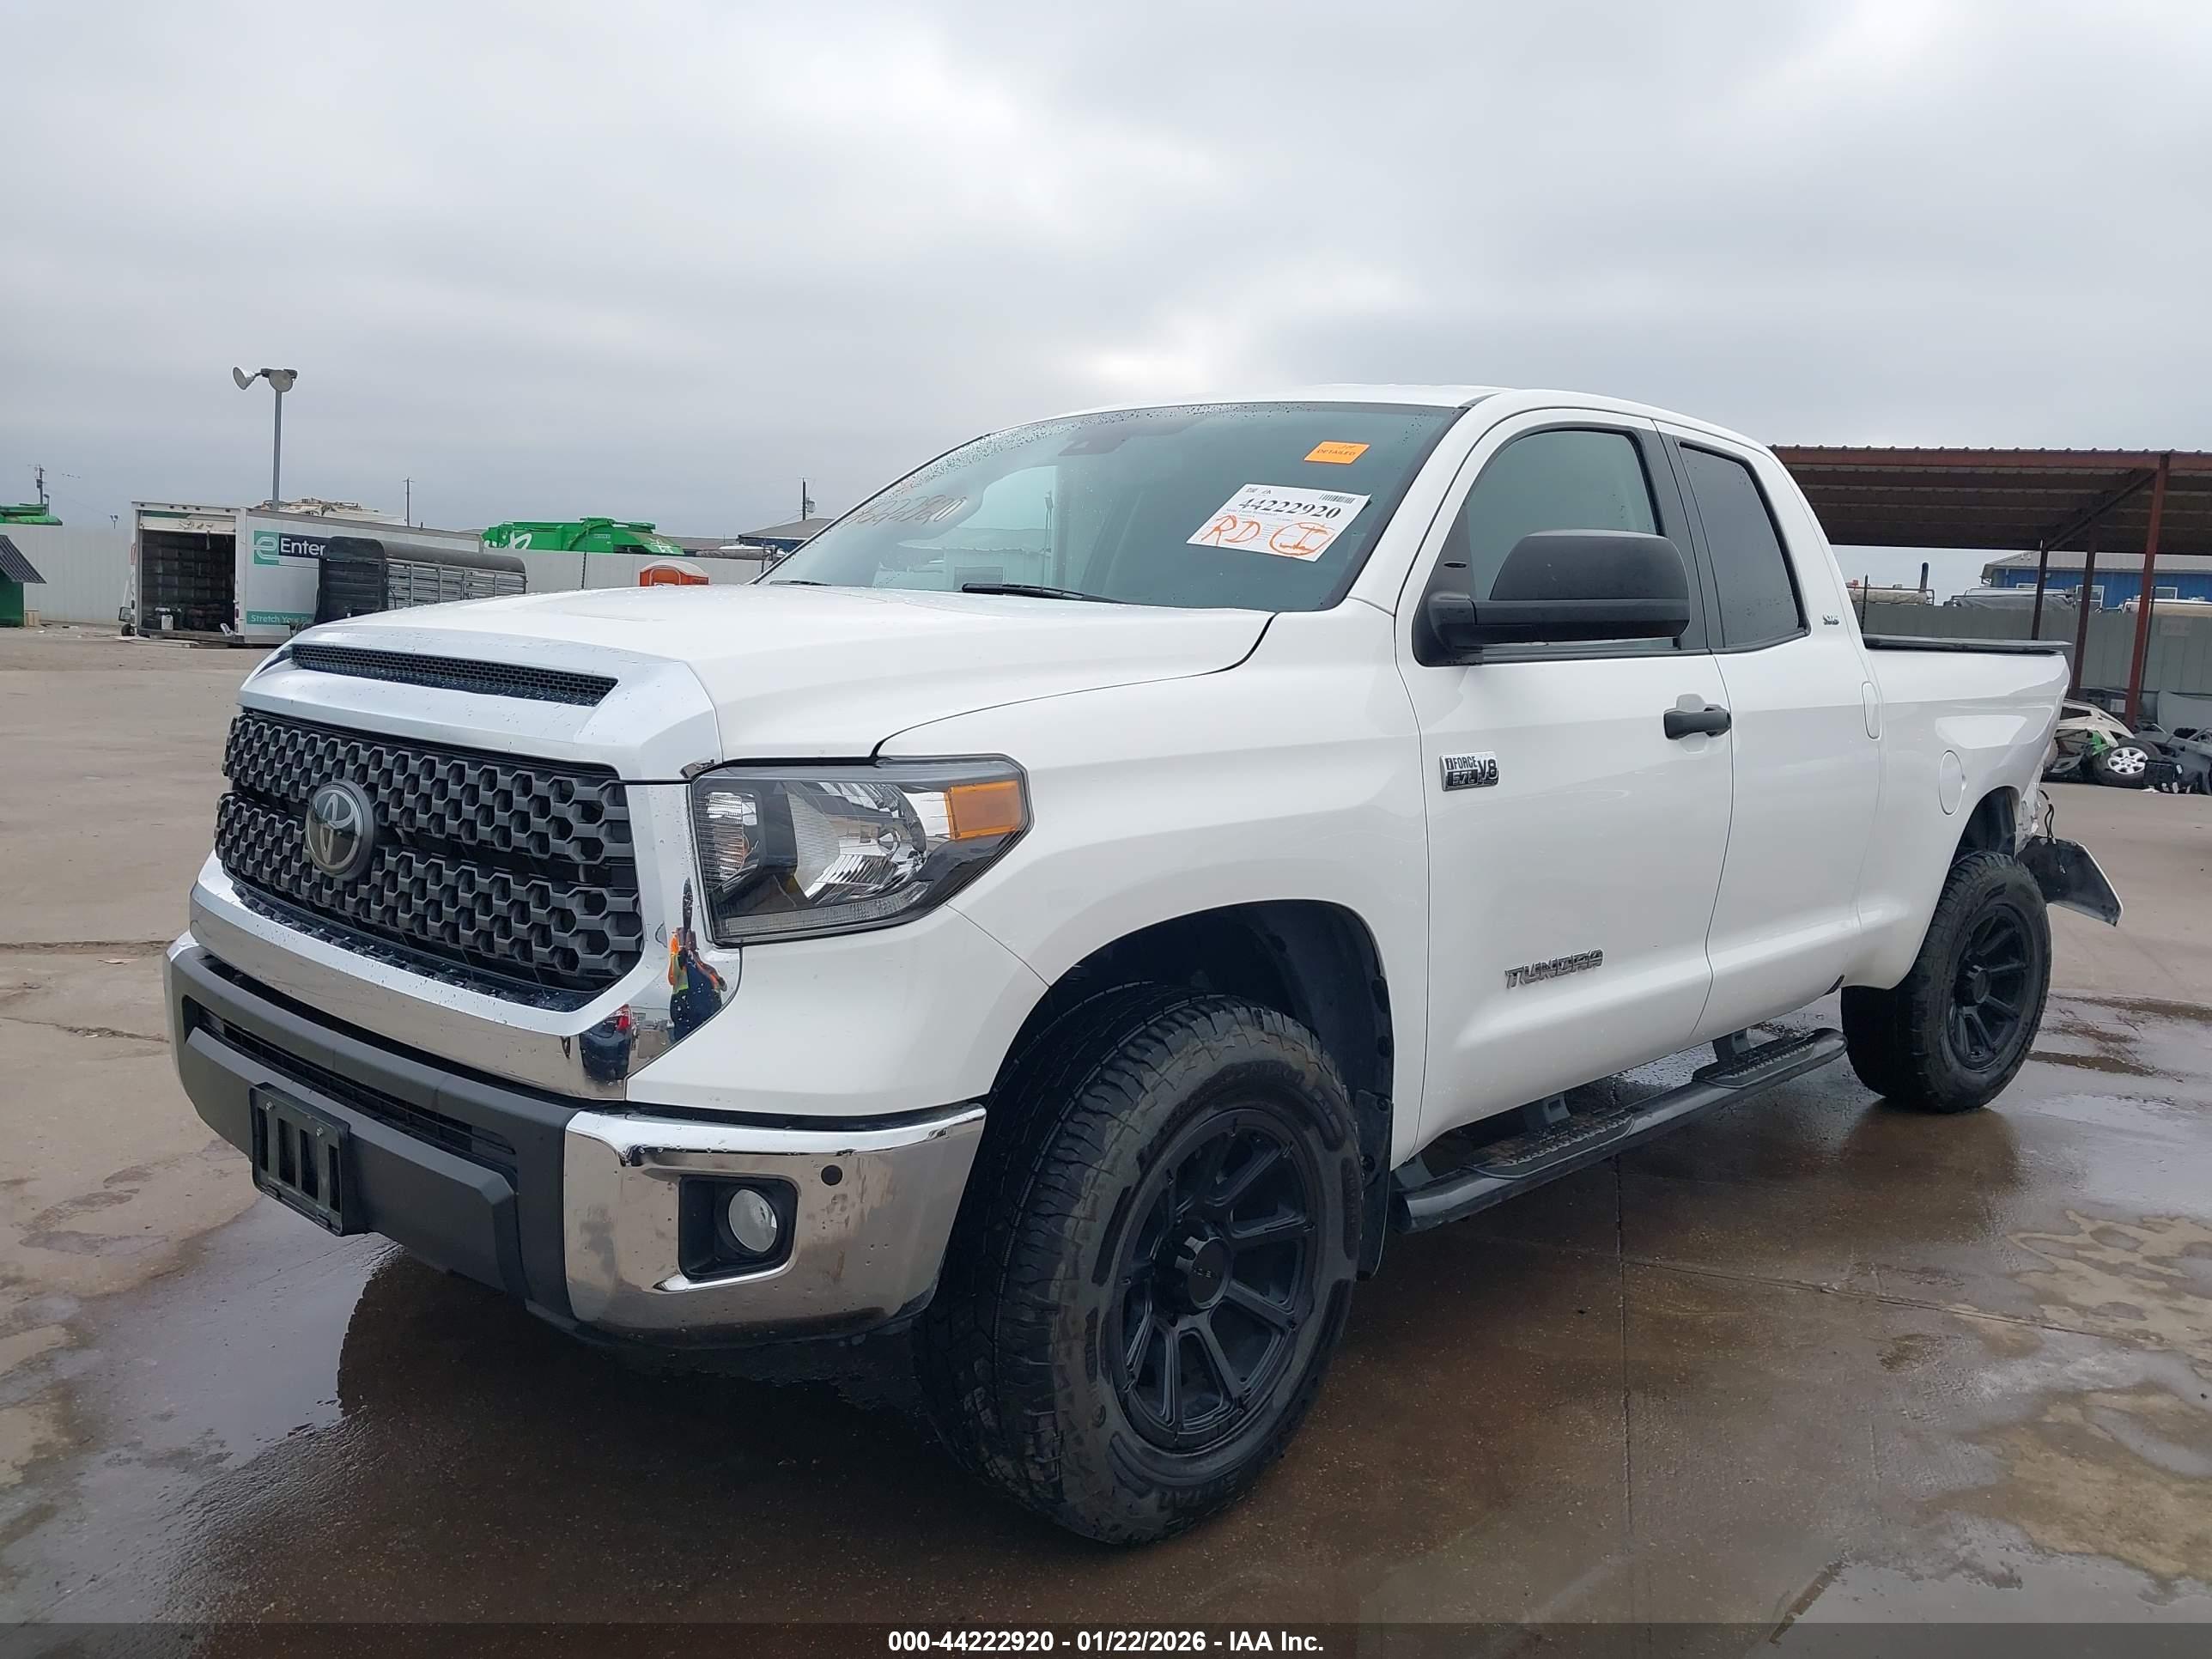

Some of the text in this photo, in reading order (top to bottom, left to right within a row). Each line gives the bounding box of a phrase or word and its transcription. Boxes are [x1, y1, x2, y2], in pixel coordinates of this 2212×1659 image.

[1238, 497, 1341, 520] 44222920
[280, 538, 326, 556] Enter
[251, 614, 280, 623] Stretch
